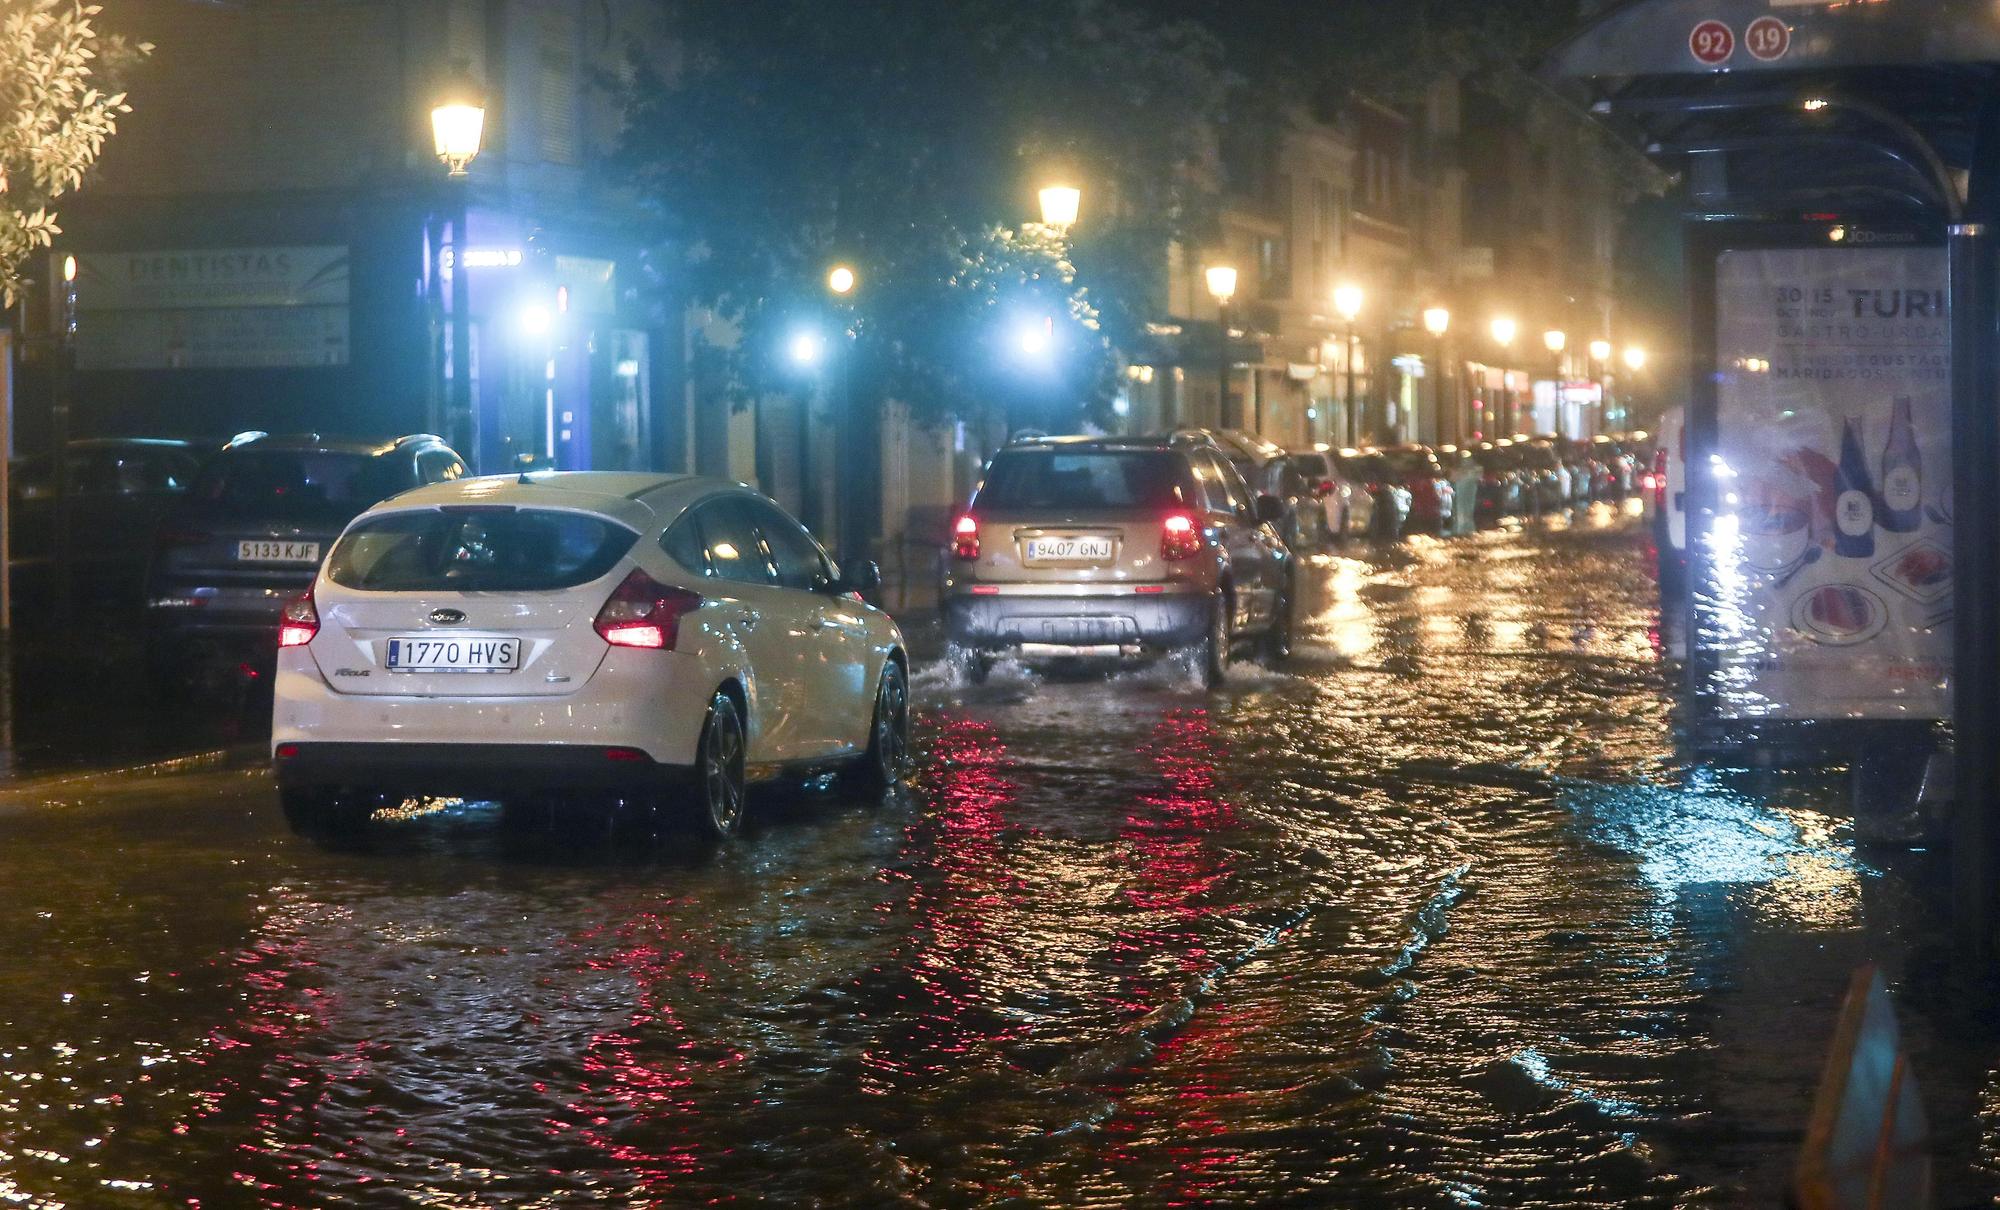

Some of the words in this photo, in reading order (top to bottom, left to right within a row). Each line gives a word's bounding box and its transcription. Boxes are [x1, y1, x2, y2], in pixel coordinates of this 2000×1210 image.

[1698, 31, 1725, 54] 92
[1755, 27, 1780, 51] 19
[130, 253, 292, 282] DENTISTAS
[1812, 288, 1833, 303] 15
[1847, 289, 1943, 318] TURI
[242, 543, 280, 558] 5133
[285, 543, 314, 559] KJF
[1038, 542, 1075, 556] 9407
[1080, 542, 1109, 556] GNJ
[406, 642, 460, 664] 1770
[468, 642, 512, 664] HVS
